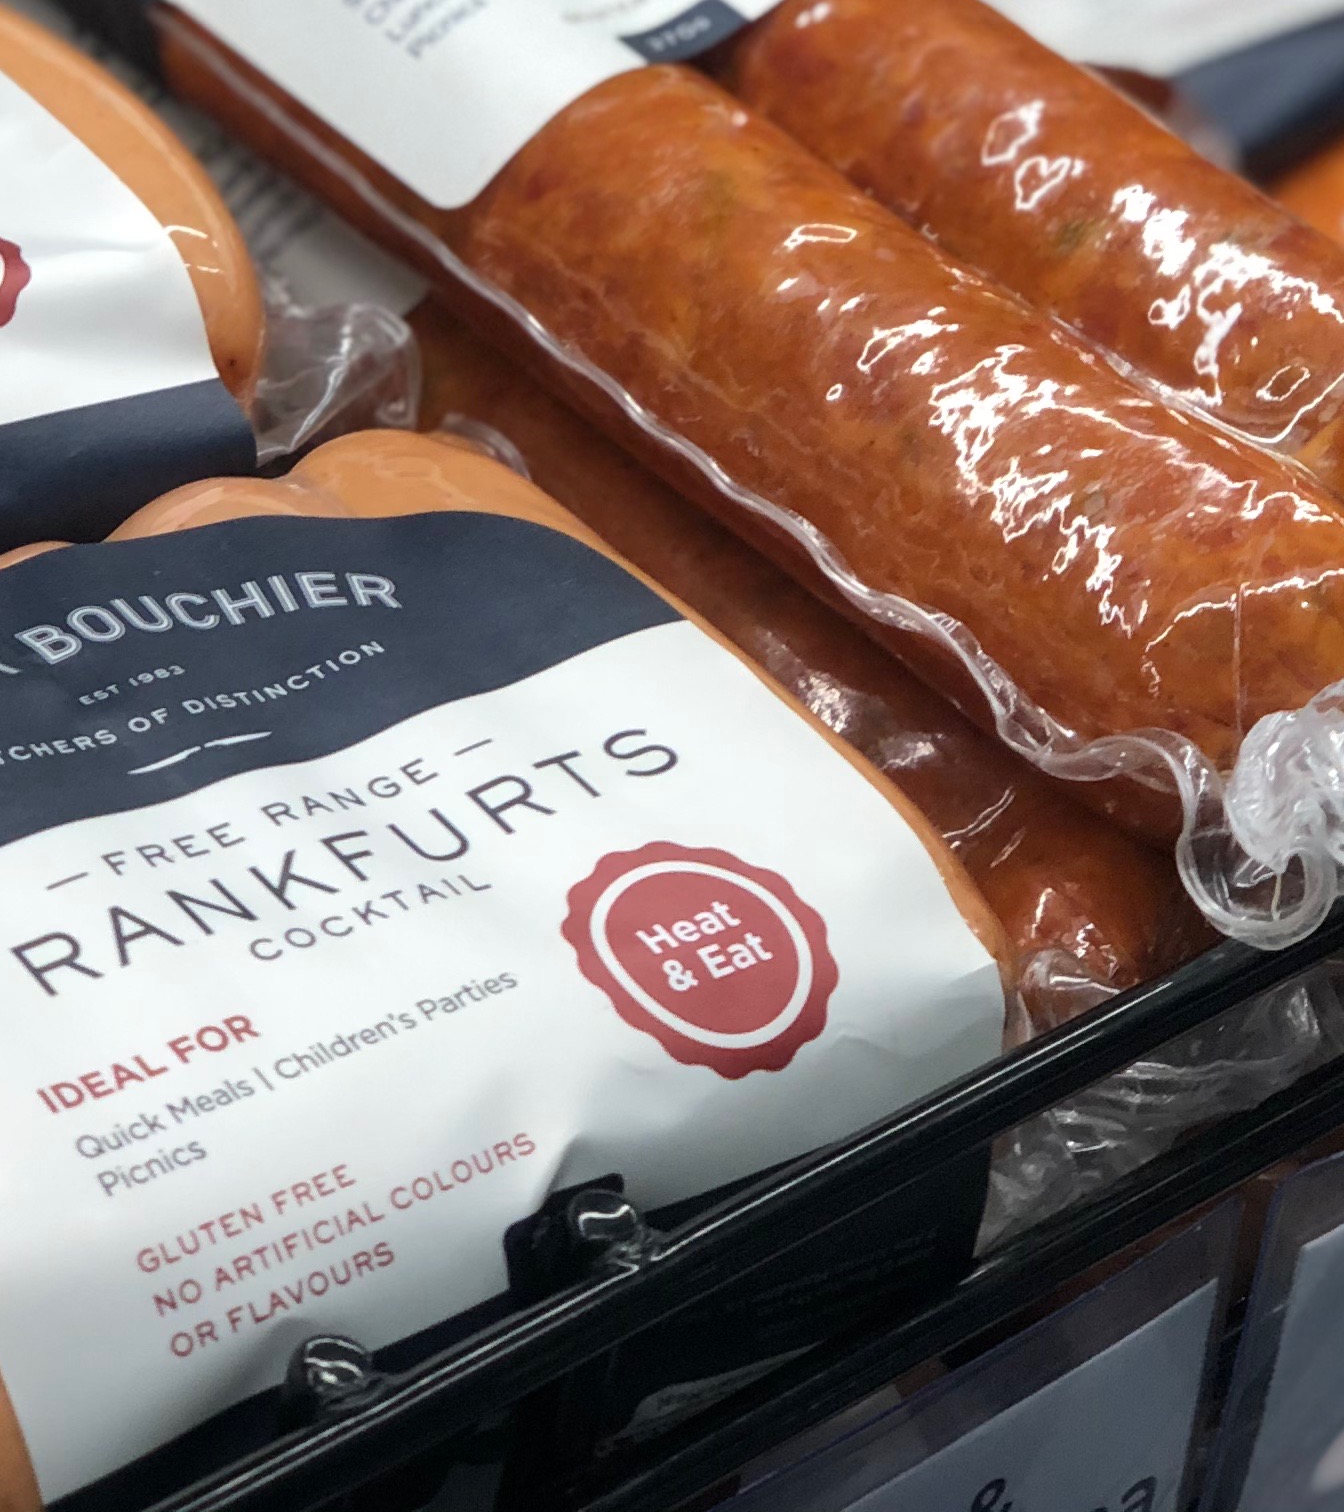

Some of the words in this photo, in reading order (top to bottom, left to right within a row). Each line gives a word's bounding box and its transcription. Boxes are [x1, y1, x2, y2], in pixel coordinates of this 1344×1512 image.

[14, 571, 403, 665] BOUCHIER
[78, 684, 120, 707] EST
[128, 664, 185, 688] 1983
[127, 708, 170, 735] OF
[181, 639, 387, 717] DISTINCTION
[100, 821, 247, 877] FREE
[260, 757, 440, 827] RANGE
[247, 871, 494, 963] COCKTAIL
[635, 900, 742, 955] Heat
[661, 959, 699, 992] &
[696, 931, 774, 979] Eat
[36, 1054, 169, 1115] IDEAL
[166, 1013, 262, 1066] FOR
[74, 1111, 167, 1162] Quick
[166, 1074, 256, 1126] Meals
[273, 1011, 418, 1082] Children's
[415, 970, 520, 1024] Parties
[97, 1138, 208, 1197] Picnics
[136, 1203, 266, 1275] GLUTEN
[269, 1162, 358, 1219] FREE
[152, 1278, 203, 1318] NO
[213, 1201, 386, 1295] ARTIFICIAL
[390, 1131, 538, 1212] COLOURS
[169, 1321, 220, 1358] OR
[227, 1240, 397, 1332] FLAVOURS
